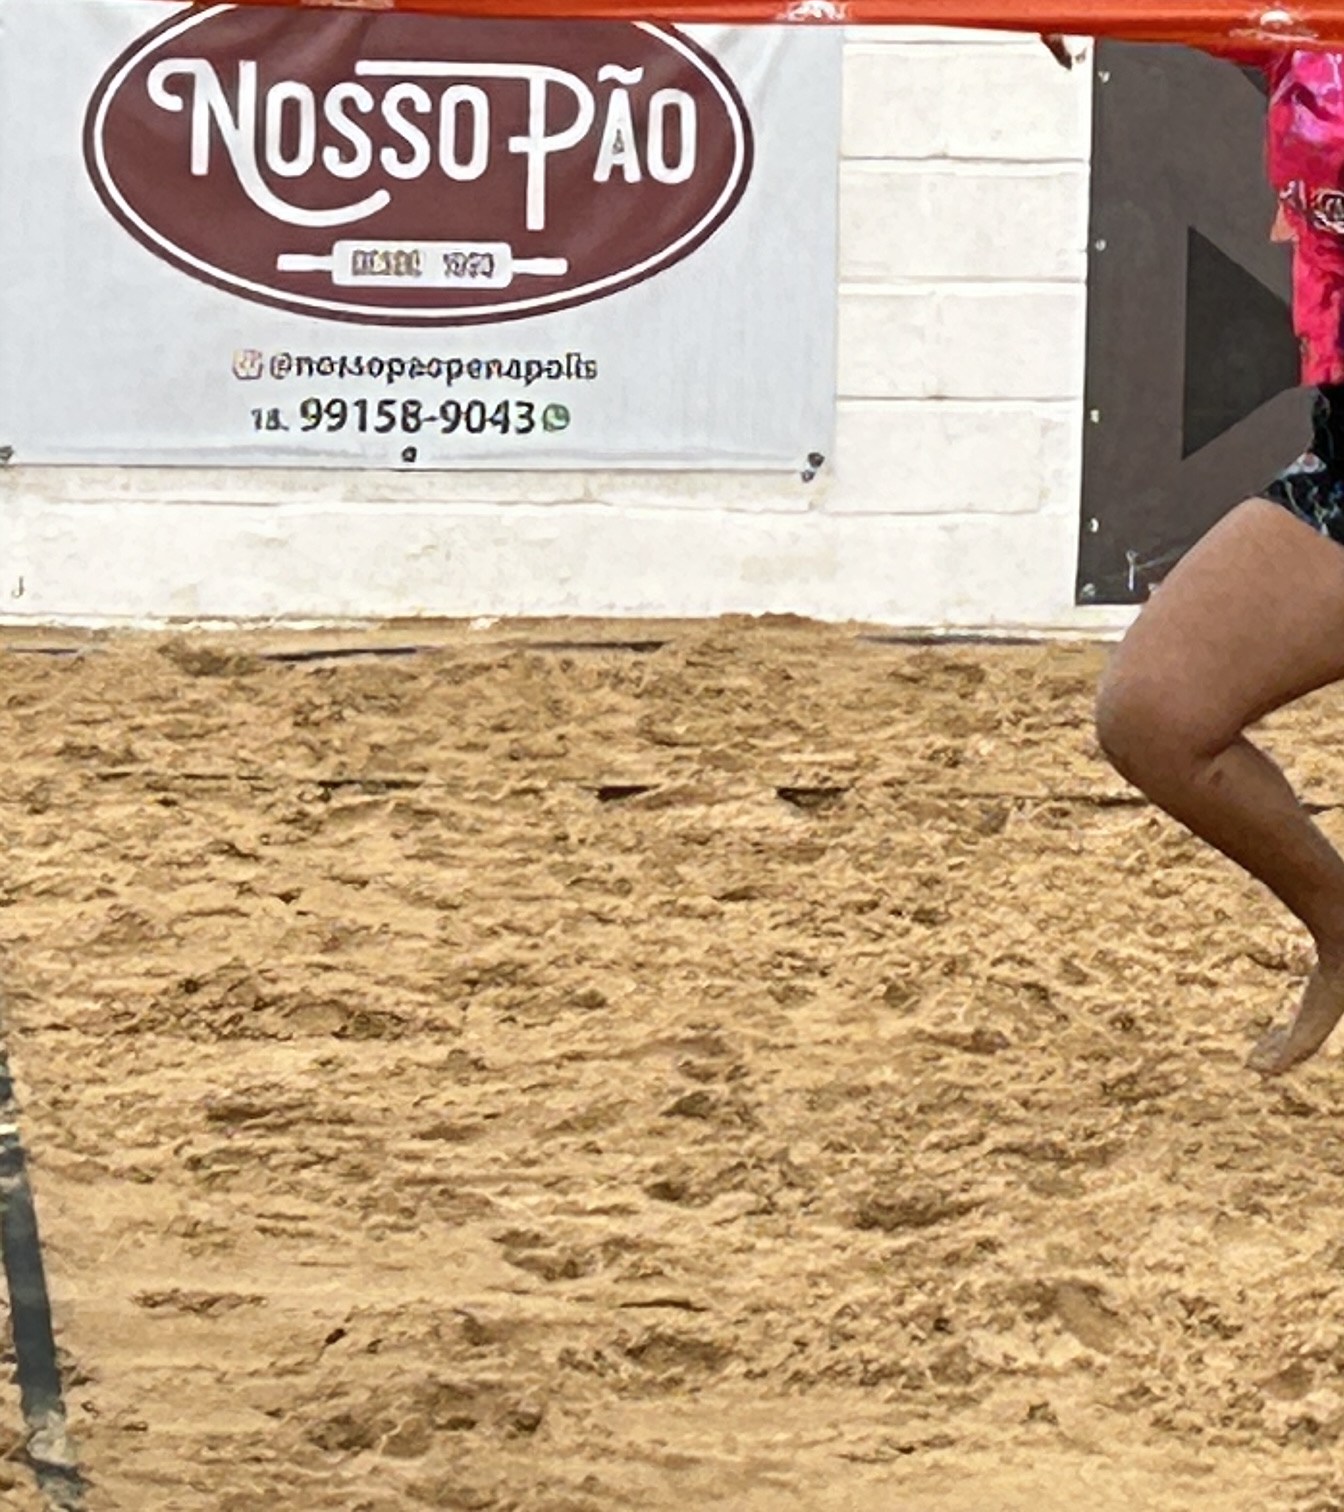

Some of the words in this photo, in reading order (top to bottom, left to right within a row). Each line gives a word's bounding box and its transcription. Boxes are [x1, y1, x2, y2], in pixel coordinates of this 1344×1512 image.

[147, 58, 490, 227] NOSSO
[355, 59, 699, 231] PÃO
[300, 398, 536, 434] 99158-9043
